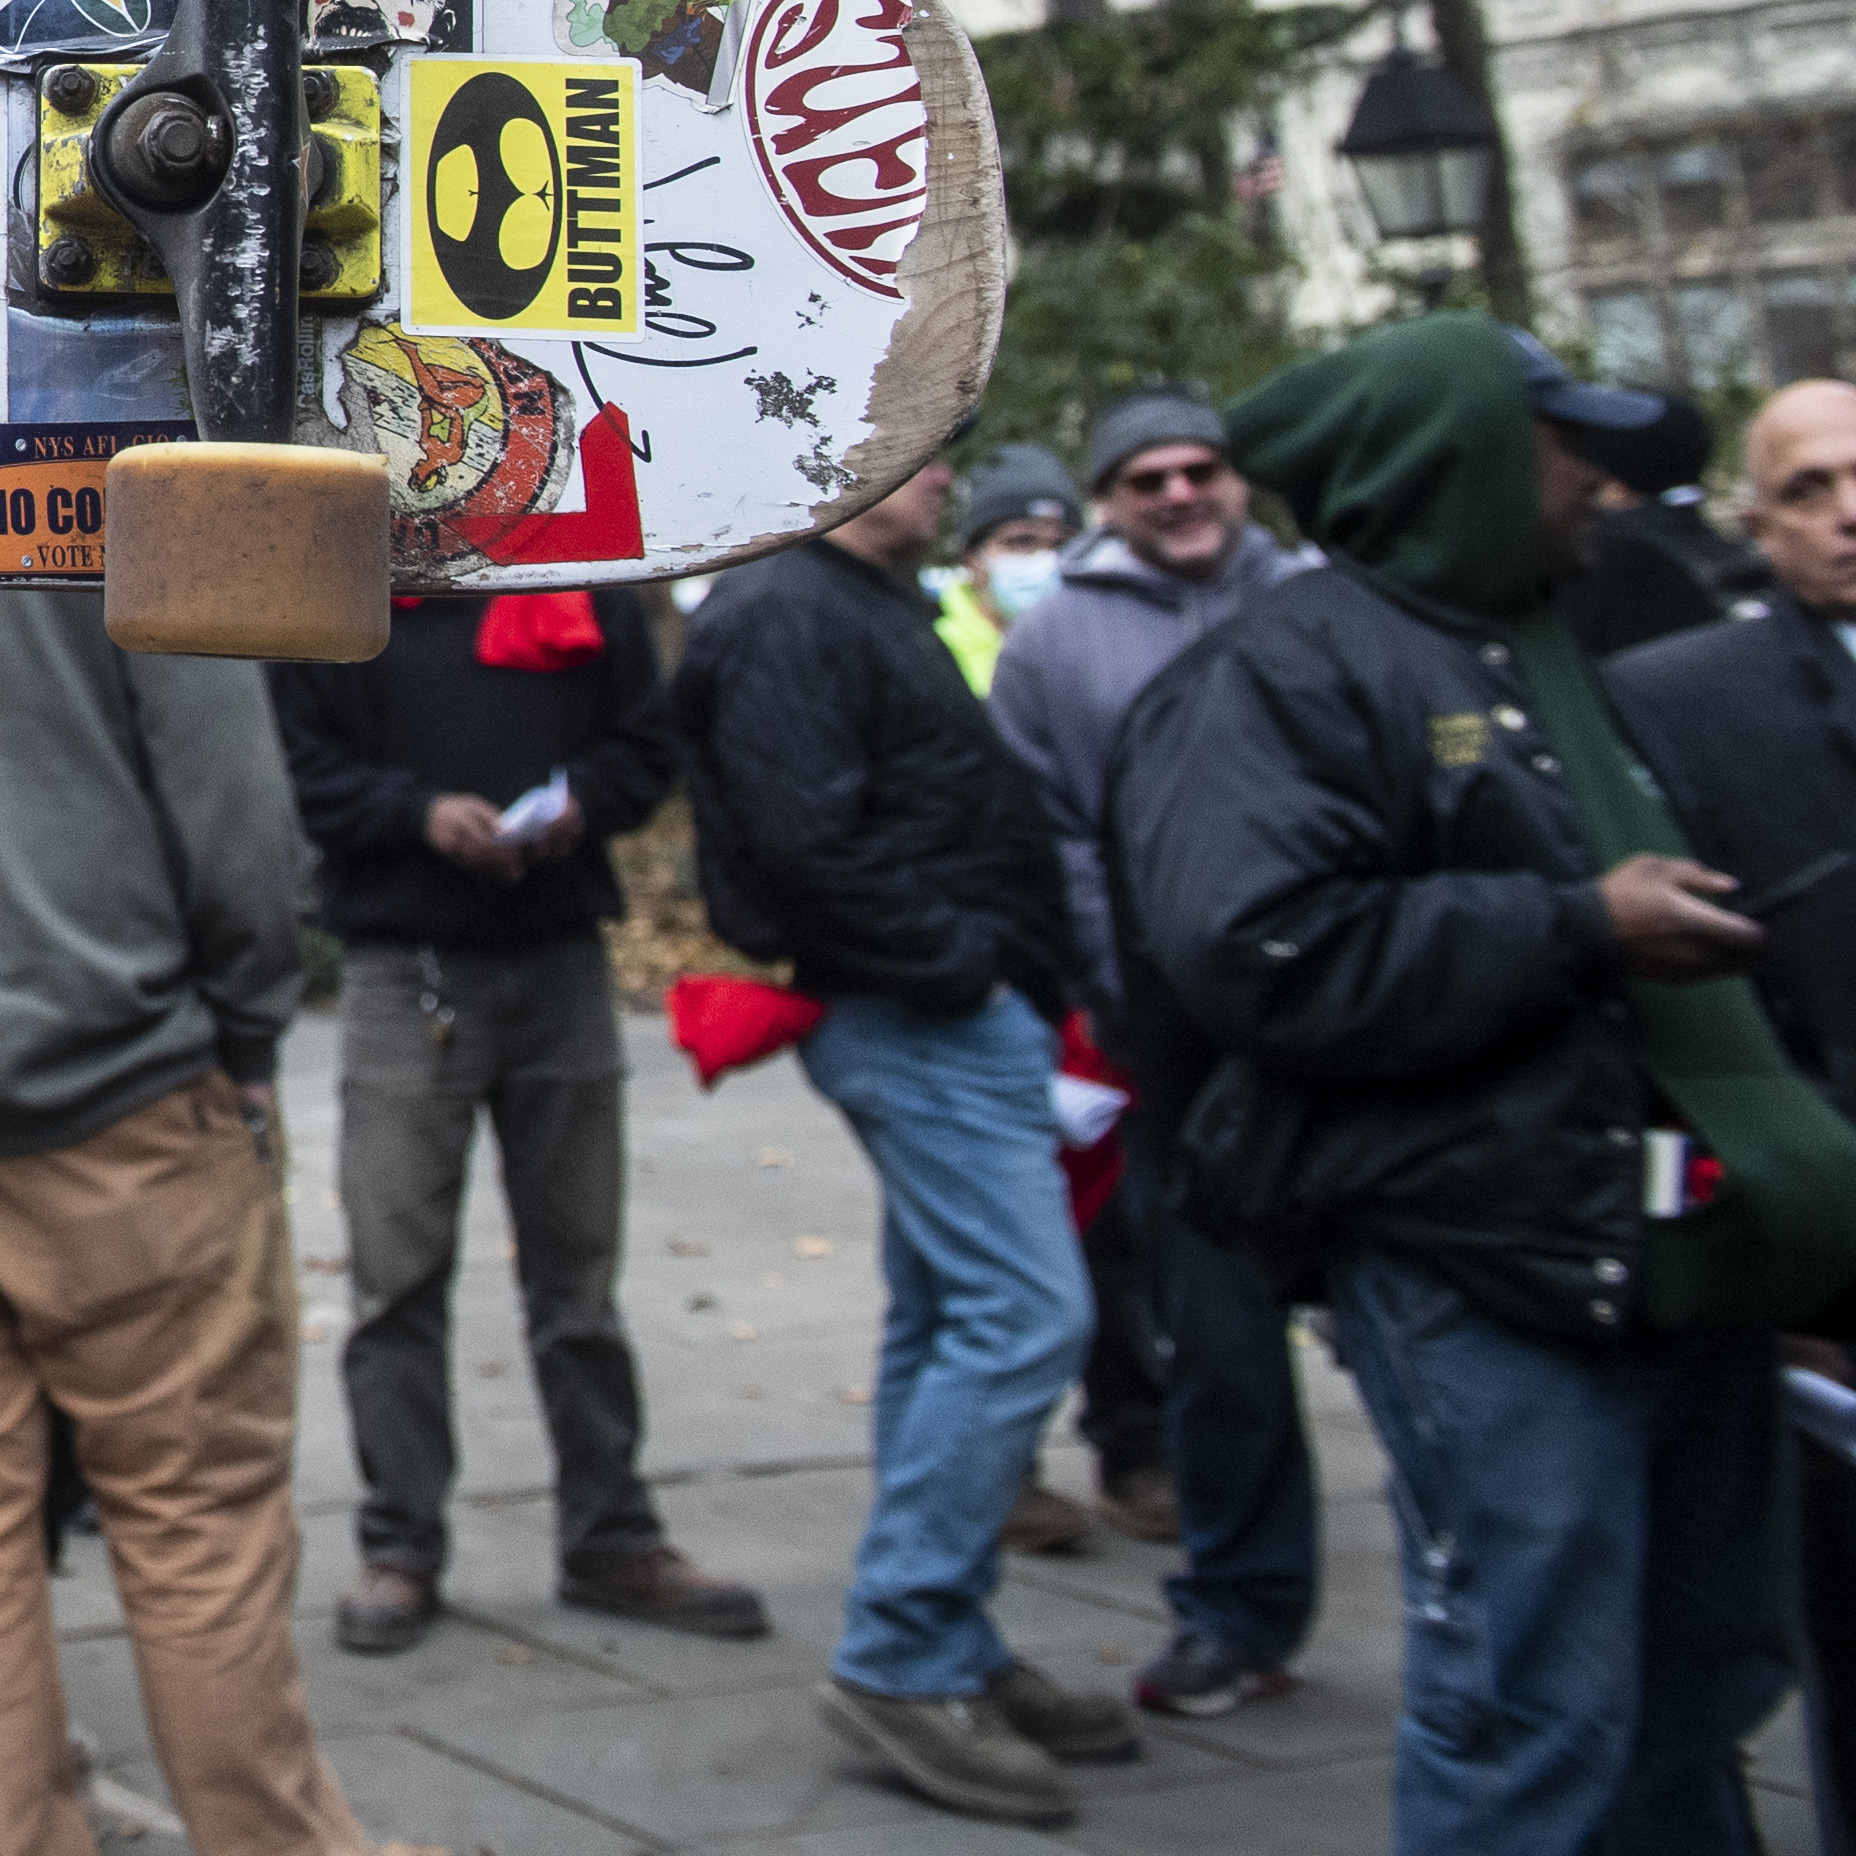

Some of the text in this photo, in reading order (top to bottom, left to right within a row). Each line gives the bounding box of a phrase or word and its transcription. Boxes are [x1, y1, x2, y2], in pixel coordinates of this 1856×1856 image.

[565, 77, 623, 320] BUTTMAN
[33, 436, 75, 460] NYS
[46, 486, 107, 536] CO
[37, 544, 94, 569] VOTE
